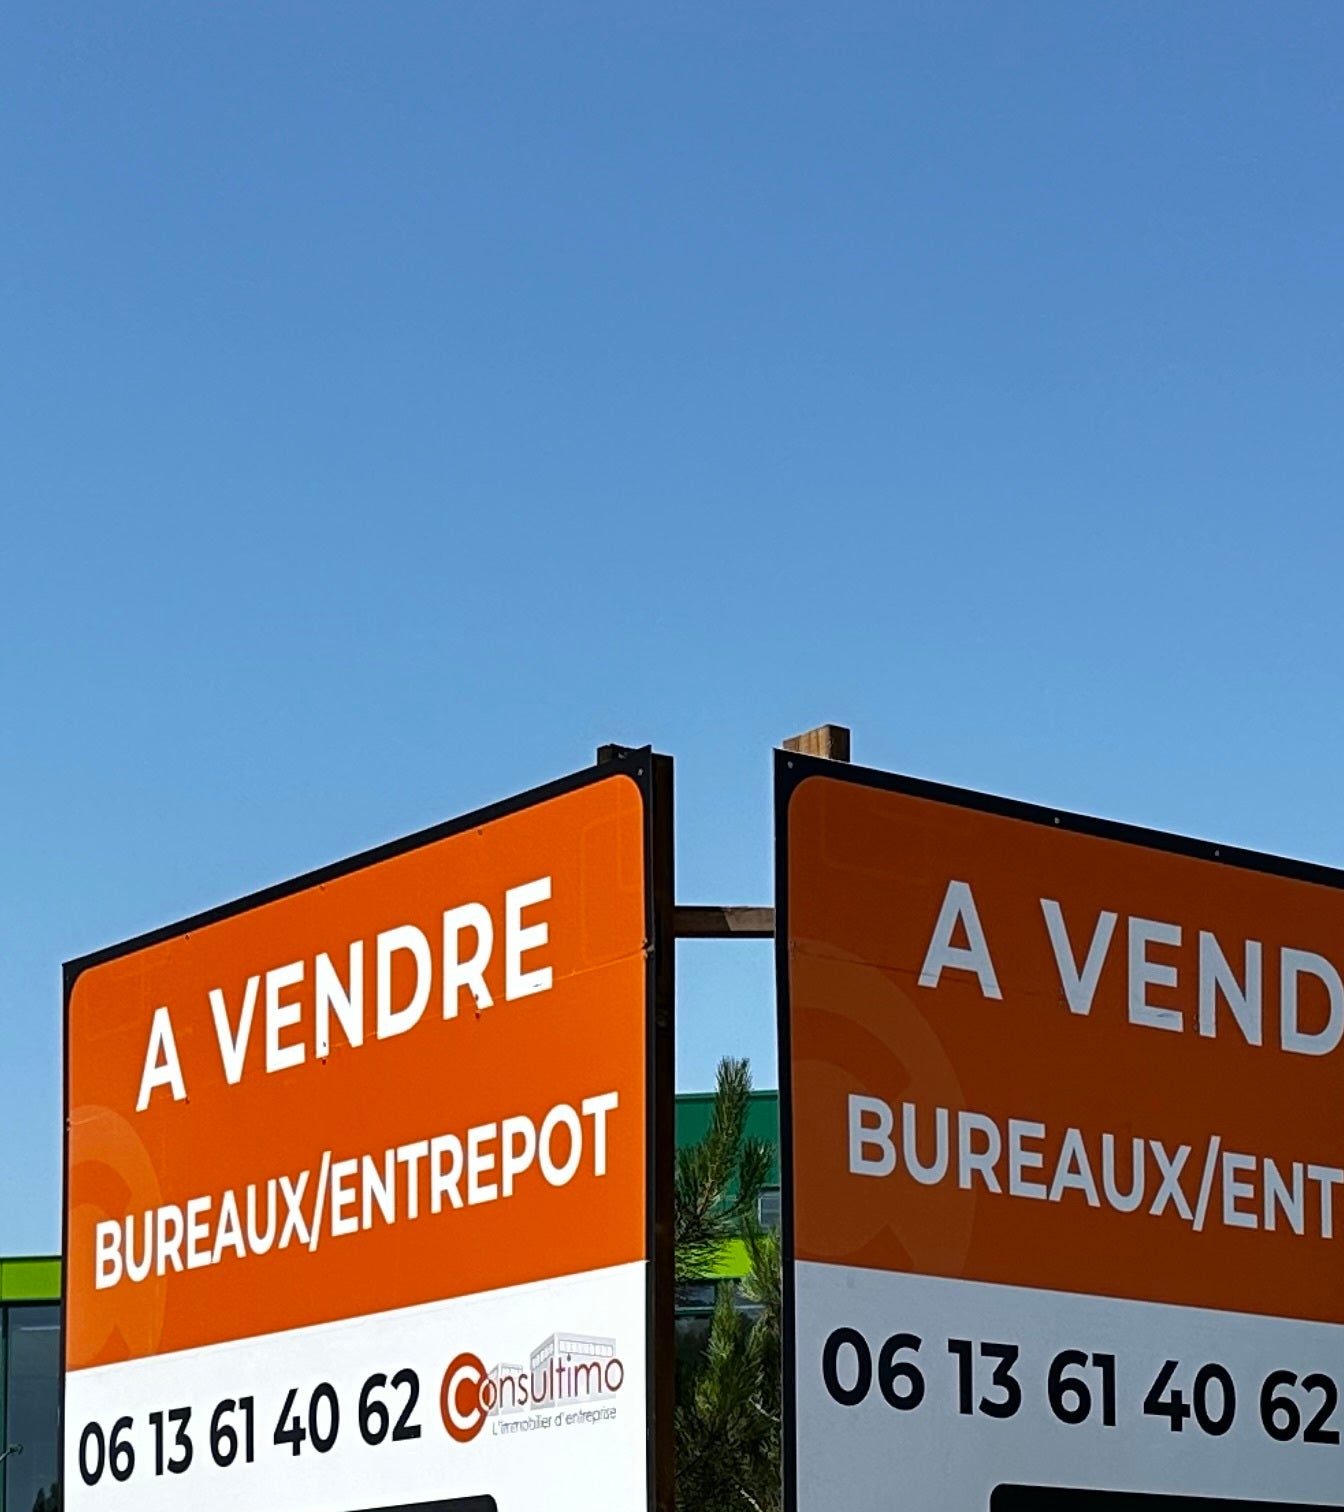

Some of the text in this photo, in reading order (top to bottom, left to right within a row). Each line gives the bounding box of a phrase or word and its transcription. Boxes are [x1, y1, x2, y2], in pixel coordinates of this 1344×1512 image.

[136, 877, 554, 1113] A VENDRE
[917, 880, 1004, 1001] A
[95, 1092, 619, 1291] BUREAUX/ENTREPOT
[79, 1368, 421, 1486] 06 13 61 40 62
[447, 1353, 624, 1430] Consultimo
[822, 1327, 1340, 1445] 06 13 61 40 62
